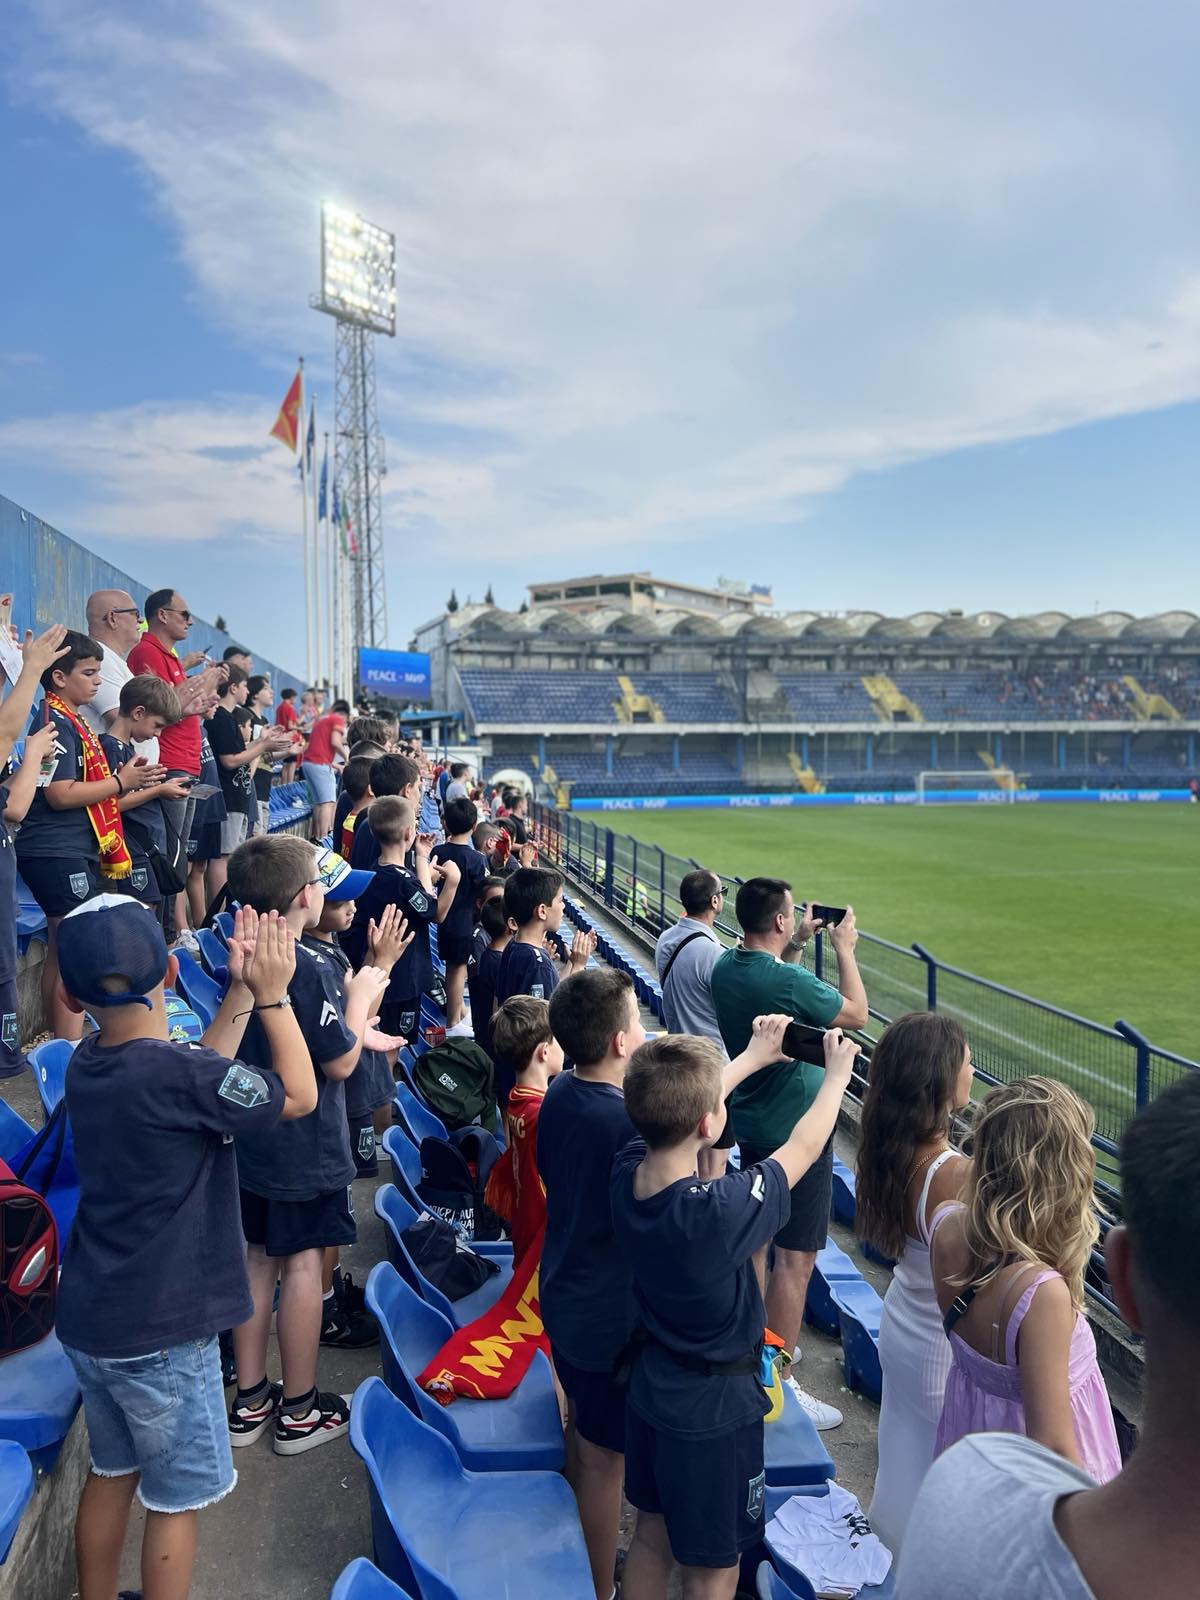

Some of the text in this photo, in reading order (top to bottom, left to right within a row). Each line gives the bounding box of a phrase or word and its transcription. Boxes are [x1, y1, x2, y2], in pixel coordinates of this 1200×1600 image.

[368, 669, 397, 682] PEACE
[1099, 792, 1130, 801] PEACE
[603, 800, 635, 809] PEACE
[730, 797, 760, 806] PEACE
